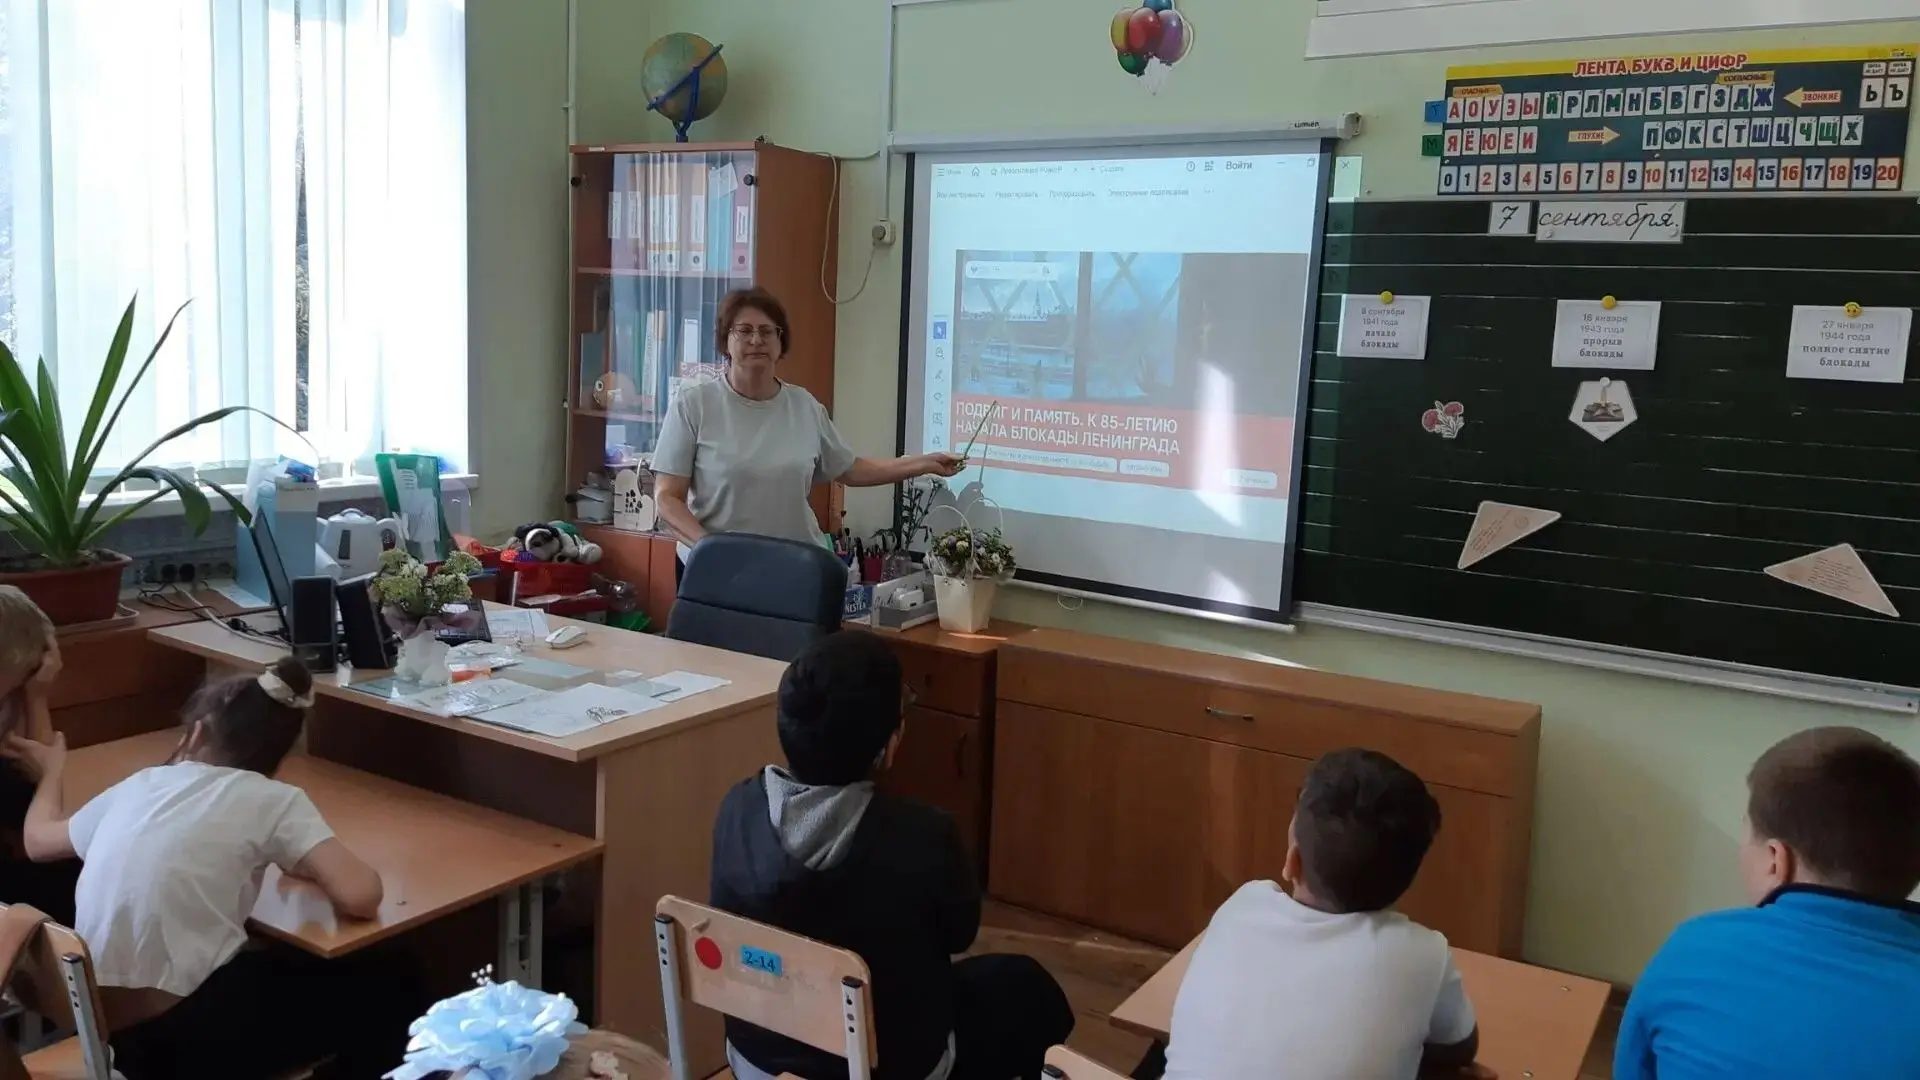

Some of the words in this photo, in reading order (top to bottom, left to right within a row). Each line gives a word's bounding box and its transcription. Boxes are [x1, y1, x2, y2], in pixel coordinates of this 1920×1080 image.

[1574, 57, 1627, 76] ЛЕНТА
[1630, 56, 1675, 75] БУКВ
[1680, 57, 1693, 72] И
[1696, 53, 1749, 72] ЦИФР
[1803, 93, 1839, 101] ЗВОНКИЕ
[1889, 83, 1904, 101] Ъ
[1449, 101, 1460, 118] А
[1469, 100, 1478, 117] О
[1489, 99, 1500, 116] У
[1506, 99, 1516, 116] Э
[1523, 97, 1539, 115] Ы
[1546, 93, 1558, 114] Й
[1566, 95, 1579, 114] Р
[1585, 95, 1599, 113] Л
[1605, 94, 1621, 112] М
[1628, 93, 1642, 111] Н
[1650, 92, 1662, 111] Б
[1669, 91, 1682, 109] В
[1693, 91, 1705, 108] Г
[1713, 89, 1725, 107] З
[1733, 88, 1750, 110] Д
[1754, 88, 1772, 106] Ж
[1646, 127, 1659, 146] П
[1665, 126, 1682, 144] Ф
[1689, 126, 1702, 144] К
[1713, 125, 1724, 144] С
[1735, 124, 1747, 143] Т
[1752, 123, 1769, 142] Ш
[1775, 122, 1791, 144] Ц
[1800, 121, 1811, 140] Ч
[1819, 121, 1837, 143] Щ
[1844, 121, 1859, 141] Х
[1447, 134, 1458, 152] Я
[1465, 131, 1474, 151] Ё
[1482, 132, 1496, 150] Ю
[1503, 132, 1513, 149] Е
[1523, 131, 1534, 148] И
[1225, 160, 1252, 171] Войти
[1444, 172, 1452, 187] 0
[1464, 172, 1471, 186] 1
[1482, 171, 1491, 185] 2
[1502, 171, 1511, 185] 3
[1522, 171, 1531, 185] 4
[1543, 170, 1552, 184] 5
[1563, 170, 1572, 184] 6
[1585, 169, 1594, 184] 7
[1606, 169, 1615, 183] 8
[1627, 169, 1636, 183] 9
[1645, 168, 1661, 183] 10
[1669, 168, 1684, 182] 11
[1691, 167, 1706, 182] 12
[1713, 167, 1729, 181] 13
[1736, 166, 1753, 181] 14
[1758, 166, 1775, 181] 15
[1782, 165, 1798, 181] 16
[1806, 165, 1823, 180] 17
[1830, 165, 1846, 180] 18
[1854, 164, 1872, 180] 19
[1877, 165, 1897, 180] 20
[1499, 206, 1519, 229] 7
[1595, 315, 1628, 324] января
[1822, 320, 1835, 328] 27
[1837, 322, 1874, 331] января
[1604, 326, 1625, 334] года
[1583, 338, 1622, 346] прорыв
[1820, 332, 1844, 340] 1944
[1846, 333, 1871, 342] года
[1361, 340, 1399, 349] блокады
[1802, 345, 1846, 354] полное
[1848, 347, 1890, 355] снятие
[1579, 349, 1624, 358] блокады
[1819, 356, 1870, 368] блокады
[956, 401, 1008, 419] ПОДВИГ
[1012, 407, 1020, 419] И
[1024, 408, 1084, 427] ПАМЯТЬ.
[1088, 413, 1097, 428] К
[1100, 414, 1178, 434] 85-ЛЕТИЮ
[955, 420, 1008, 439] НАЧАЛА
[1011, 426, 1079, 446] БЛОКАДЫ
[1080, 431, 1180, 456] ЛЕНИНГРАДА
[744, 950, 775, 973] 2-14
